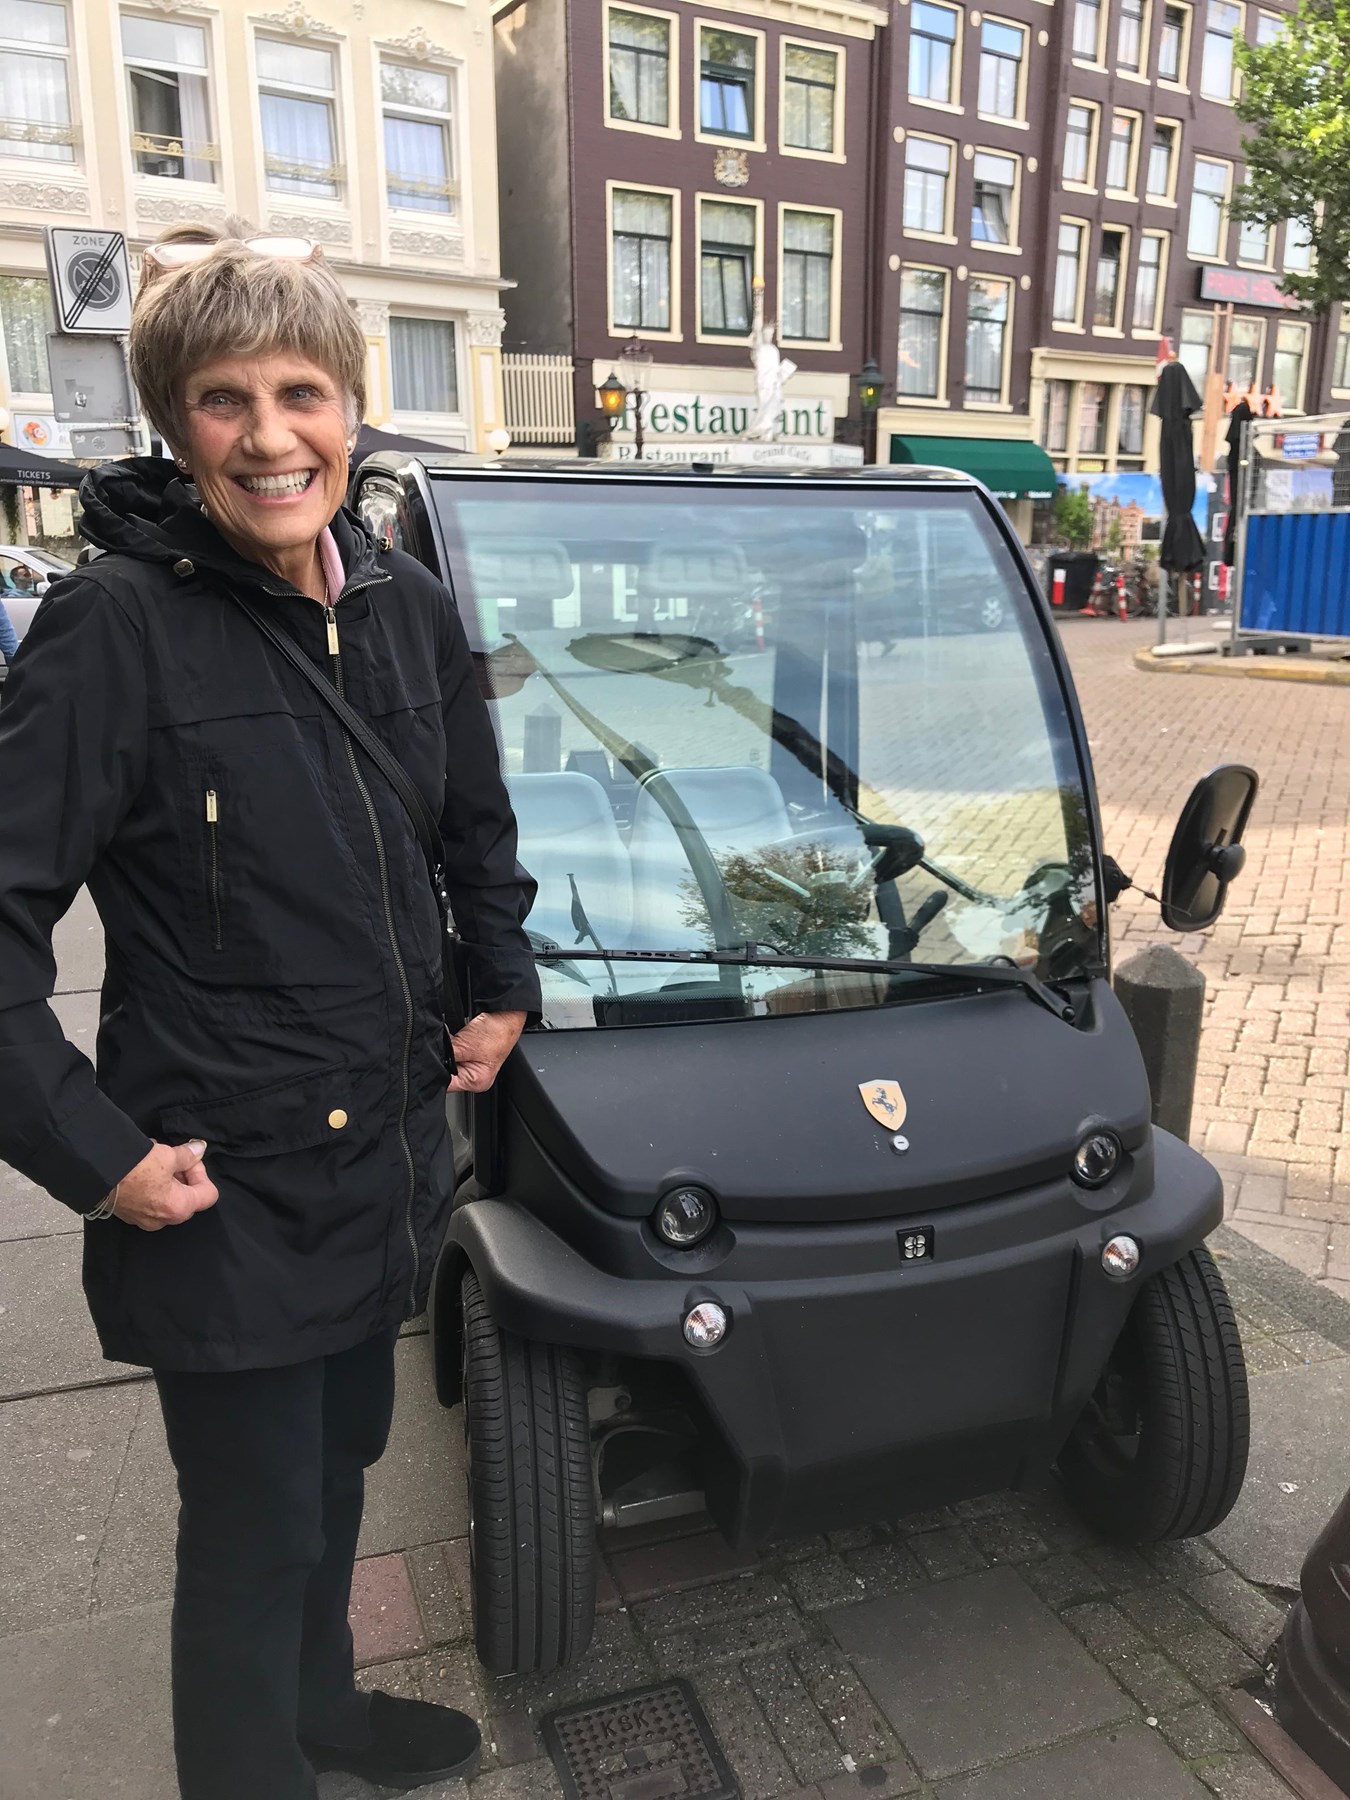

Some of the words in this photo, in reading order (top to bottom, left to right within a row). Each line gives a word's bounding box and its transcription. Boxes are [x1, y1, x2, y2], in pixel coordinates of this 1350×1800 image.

[73, 235, 106, 247] ZONE
[618, 394, 829, 437] Restauant
[618, 446, 731, 462] Rstaurant
[17, 470, 51, 480] TICKETS
[601, 1710, 650, 1739] KSK
